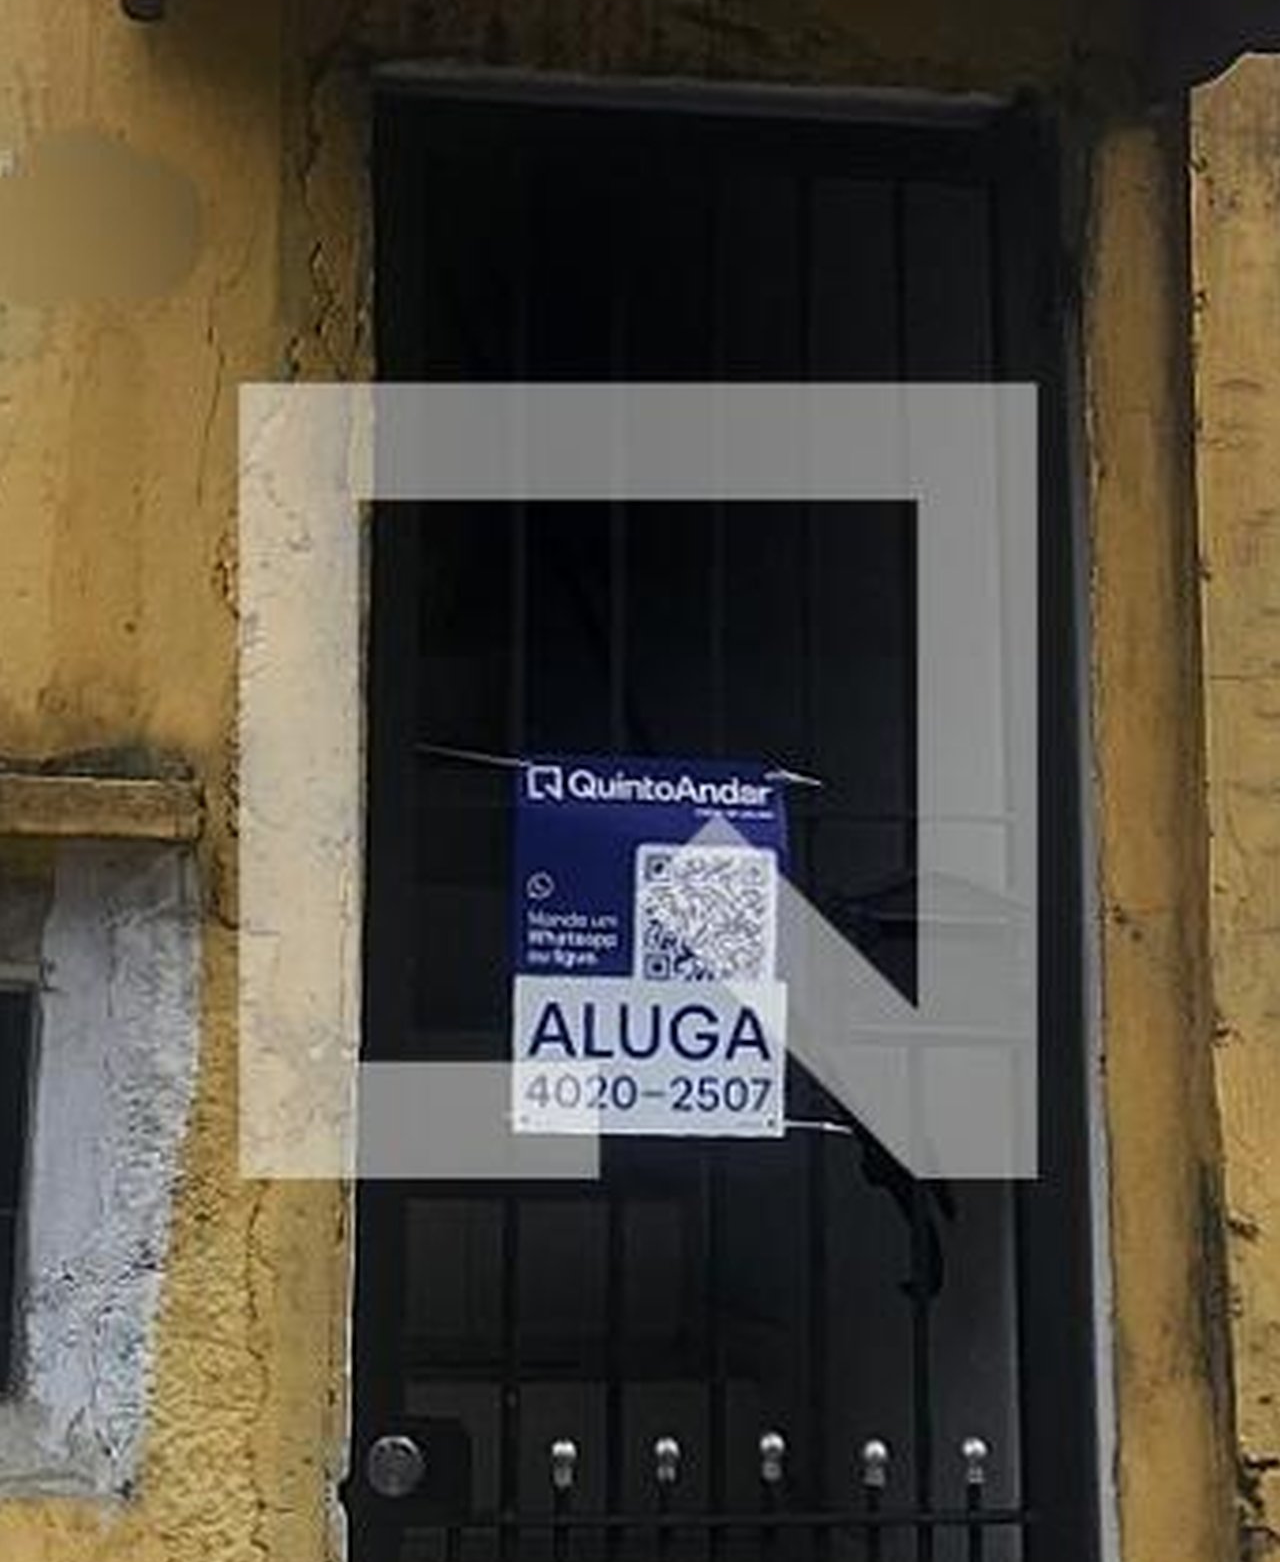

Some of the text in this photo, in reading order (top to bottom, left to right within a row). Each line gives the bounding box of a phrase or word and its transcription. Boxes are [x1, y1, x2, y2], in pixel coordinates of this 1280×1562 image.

[569, 769, 772, 805] QuintoAndar
[528, 1002, 772, 1061] ALUGA
[526, 1075, 772, 1113] 4020-2507
